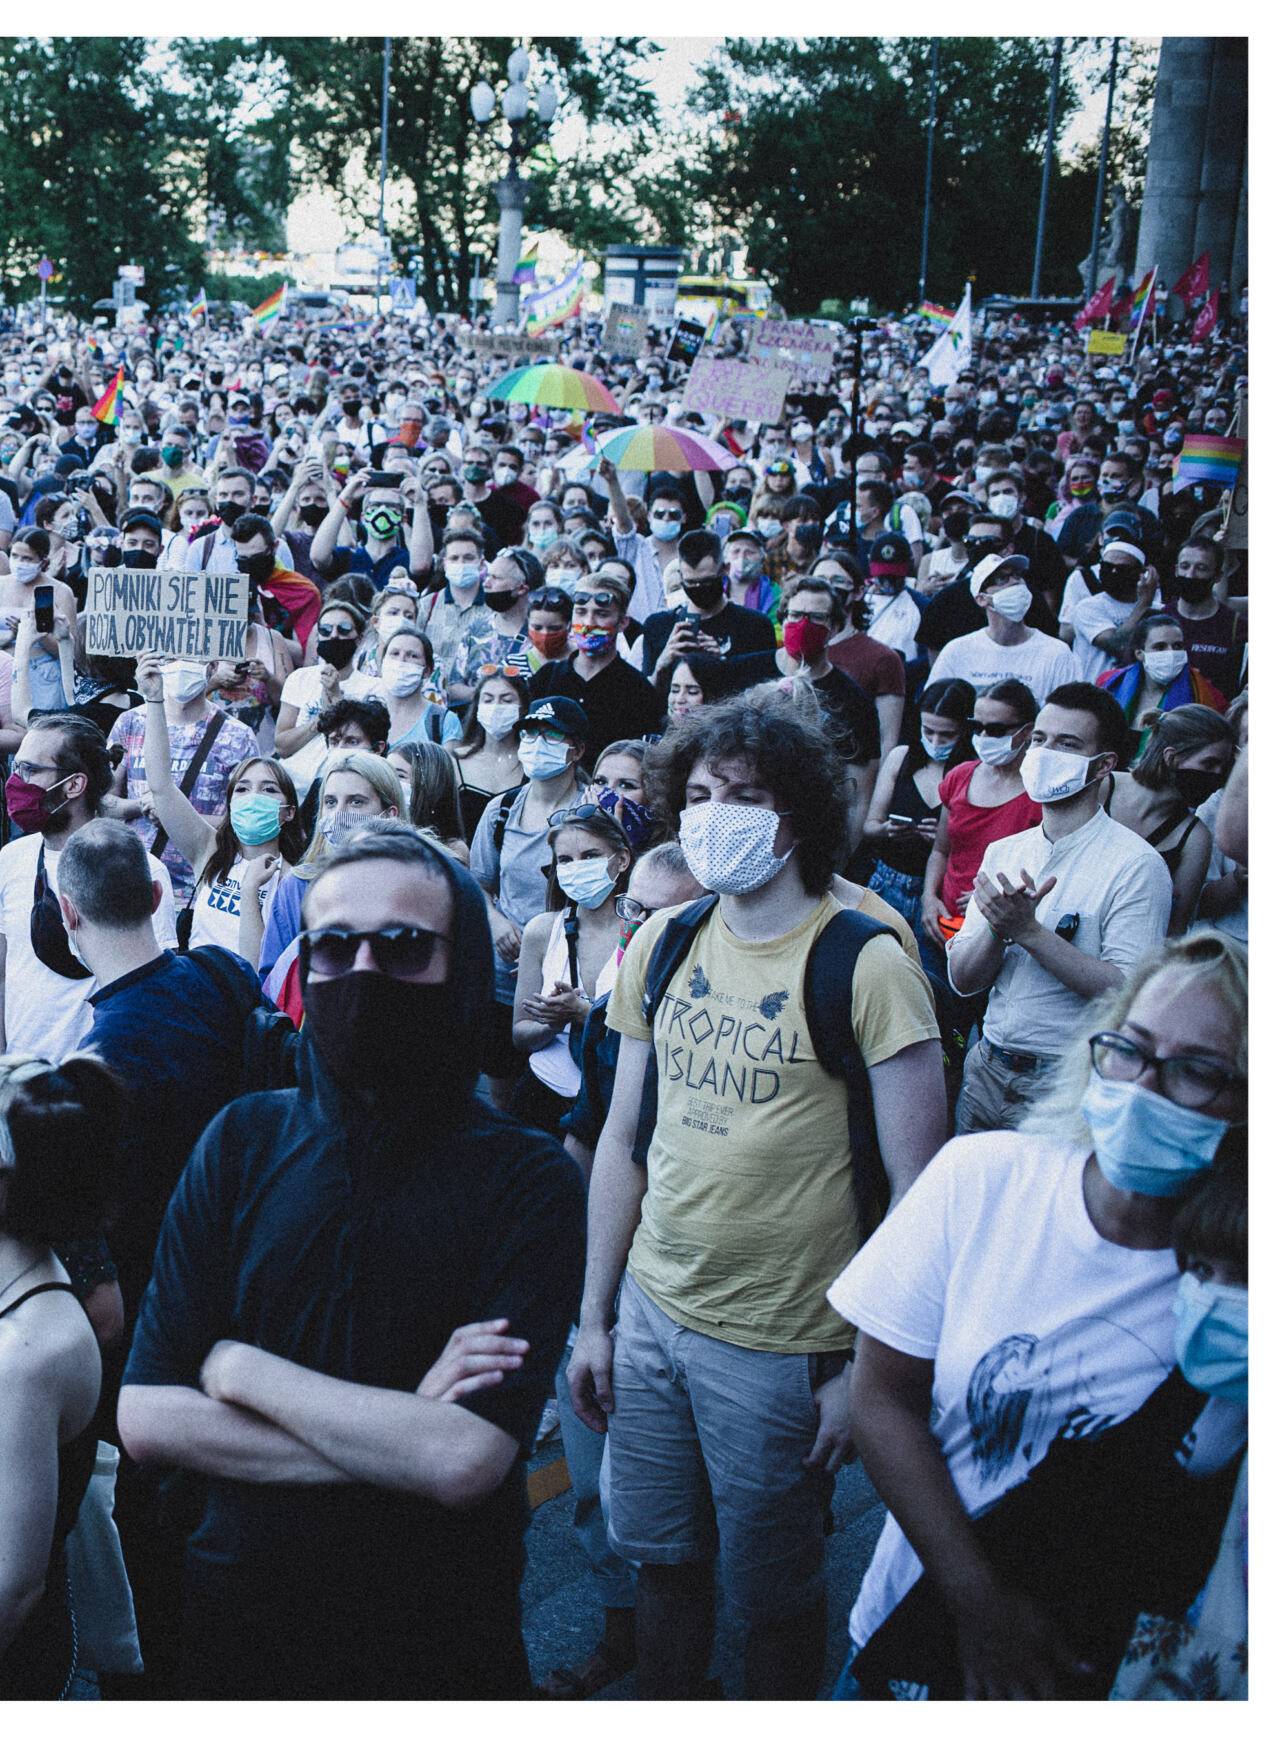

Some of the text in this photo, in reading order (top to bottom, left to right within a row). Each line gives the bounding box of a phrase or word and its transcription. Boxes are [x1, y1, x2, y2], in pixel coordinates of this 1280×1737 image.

[94, 573, 162, 611] POMNIKI
[204, 576, 240, 615] NIE
[125, 614, 213, 655] OBYWATELE
[218, 619, 248, 658] TAK
[659, 993, 806, 1064] TROPICAL
[664, 1040, 781, 1104] ISLAND
[681, 1116, 729, 1137] BIG STAR JEANS
